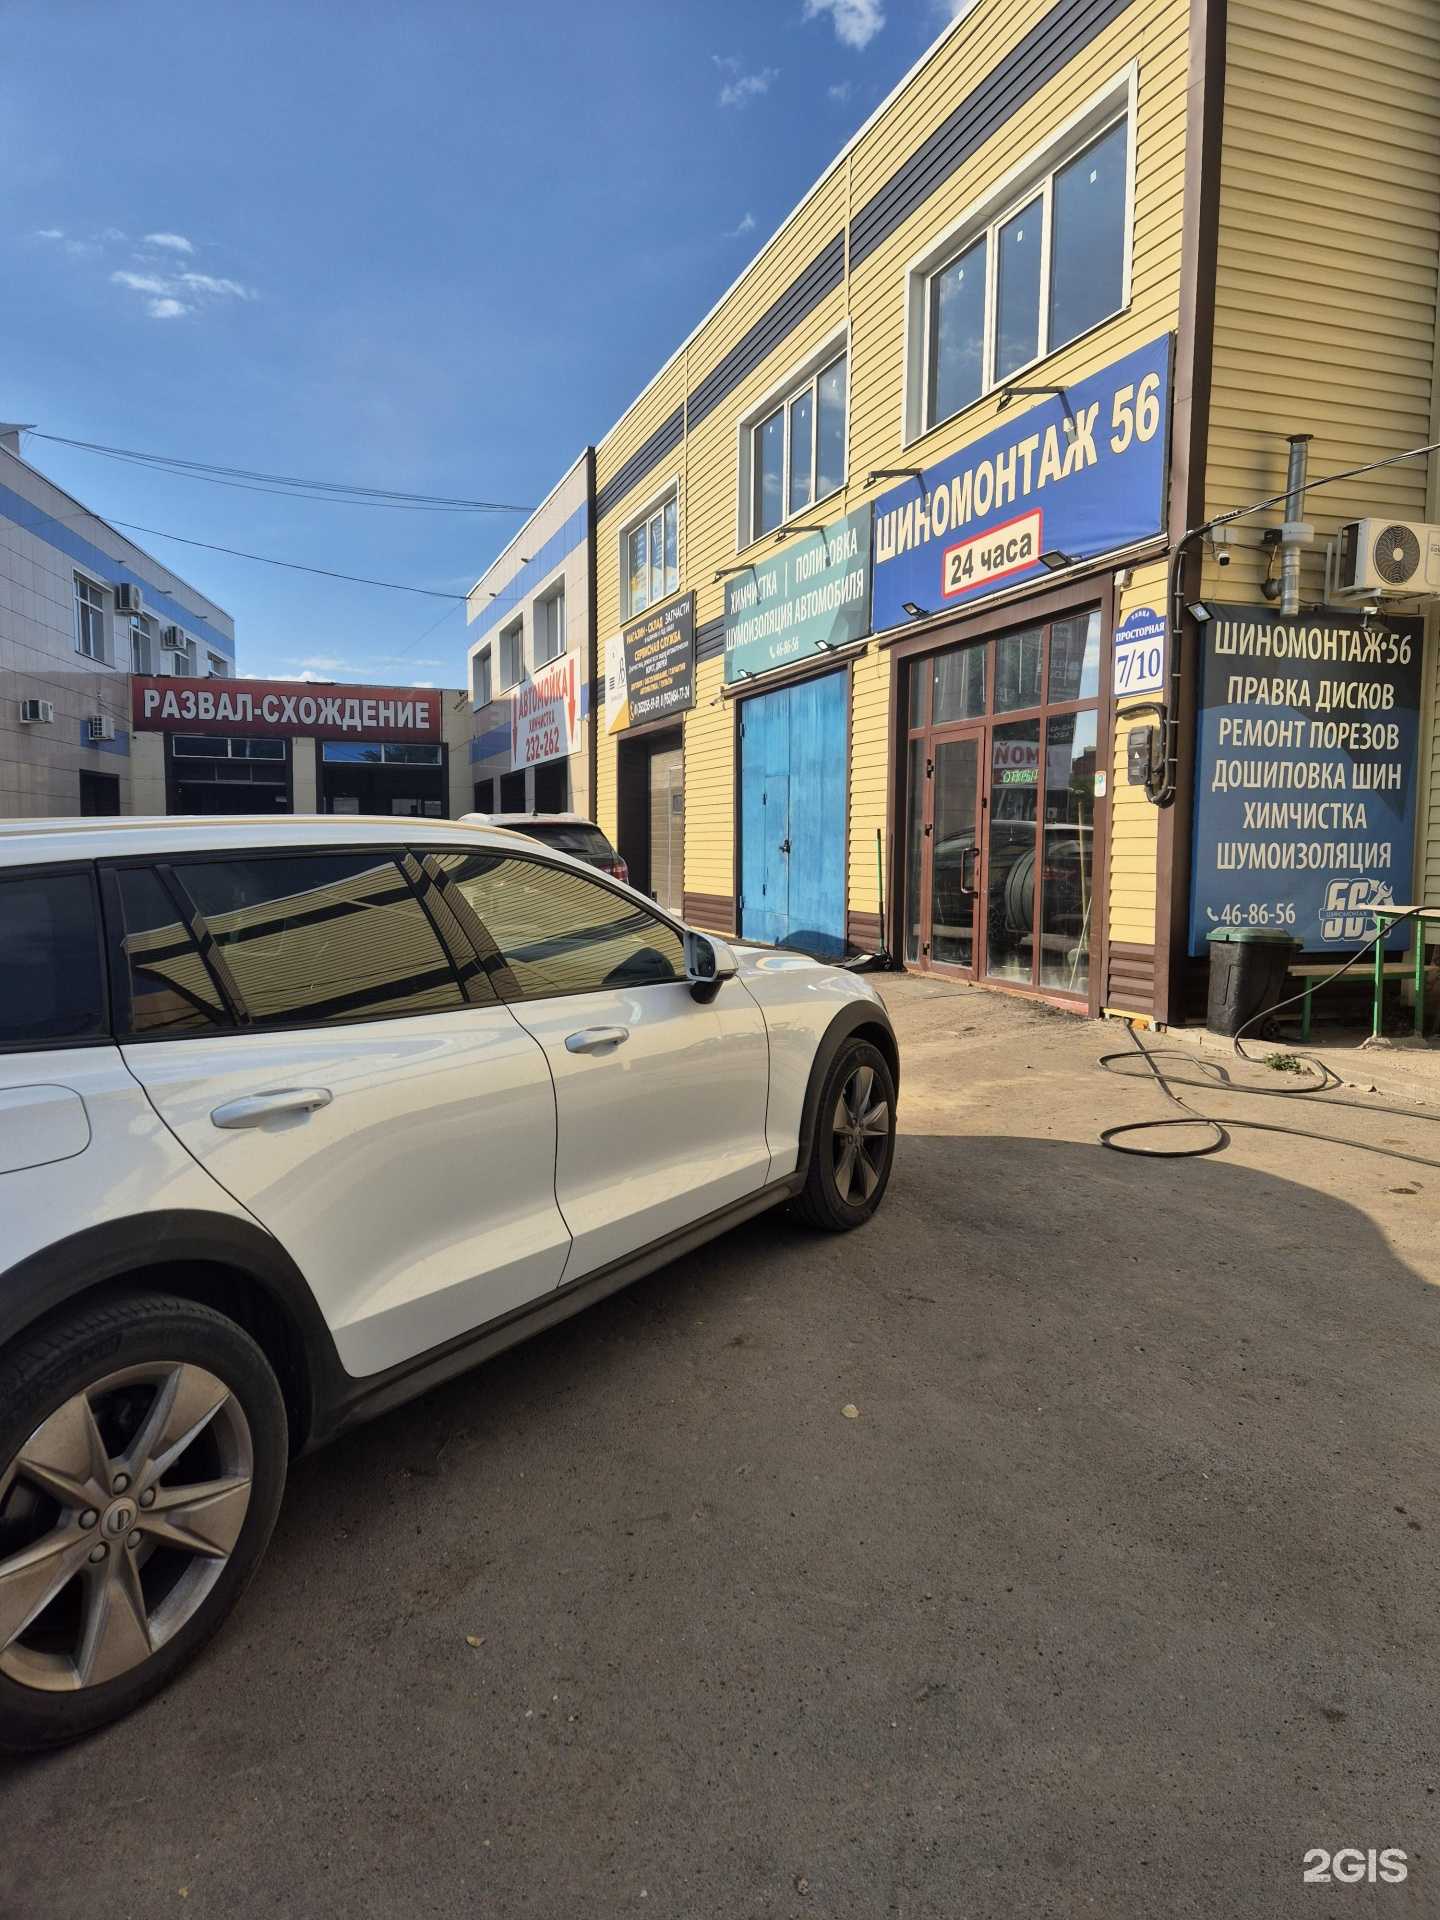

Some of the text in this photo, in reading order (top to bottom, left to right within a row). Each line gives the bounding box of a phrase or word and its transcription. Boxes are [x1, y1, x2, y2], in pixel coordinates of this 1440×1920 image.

[876, 372, 1160, 565] ШИНОМОНТАЖ 56
[950, 532, 1032, 586] 24 часа
[665, 601, 690, 625] ЗАПЧАСТИ
[726, 568, 864, 652] ШУМОИЗОЛЯЦИЯ АВТОМОБИЛЯ
[1115, 621, 1165, 643] ПРОСТОРНАЯ
[1117, 648, 1160, 688] 7/10
[143, 689, 430, 731] РАЗВАЛ-СХОЖДЕНИЕ
[519, 666, 568, 719] АВТОМОЙКА
[1227, 675, 1395, 713] ПРАВКА ДИСКОВ
[525, 726, 560, 762] 232-262
[1219, 717, 1400, 750] РЕМОНТ ПОРЕЗОВ
[1212, 759, 1401, 793] ДОШИПОВКА ШИН
[1243, 801, 1367, 830] ХИМЧИСТКА
[1216, 842, 1392, 873] ШУМОИЗОЛЯЦИЯ
[1221, 903, 1296, 925] 46-86-56
